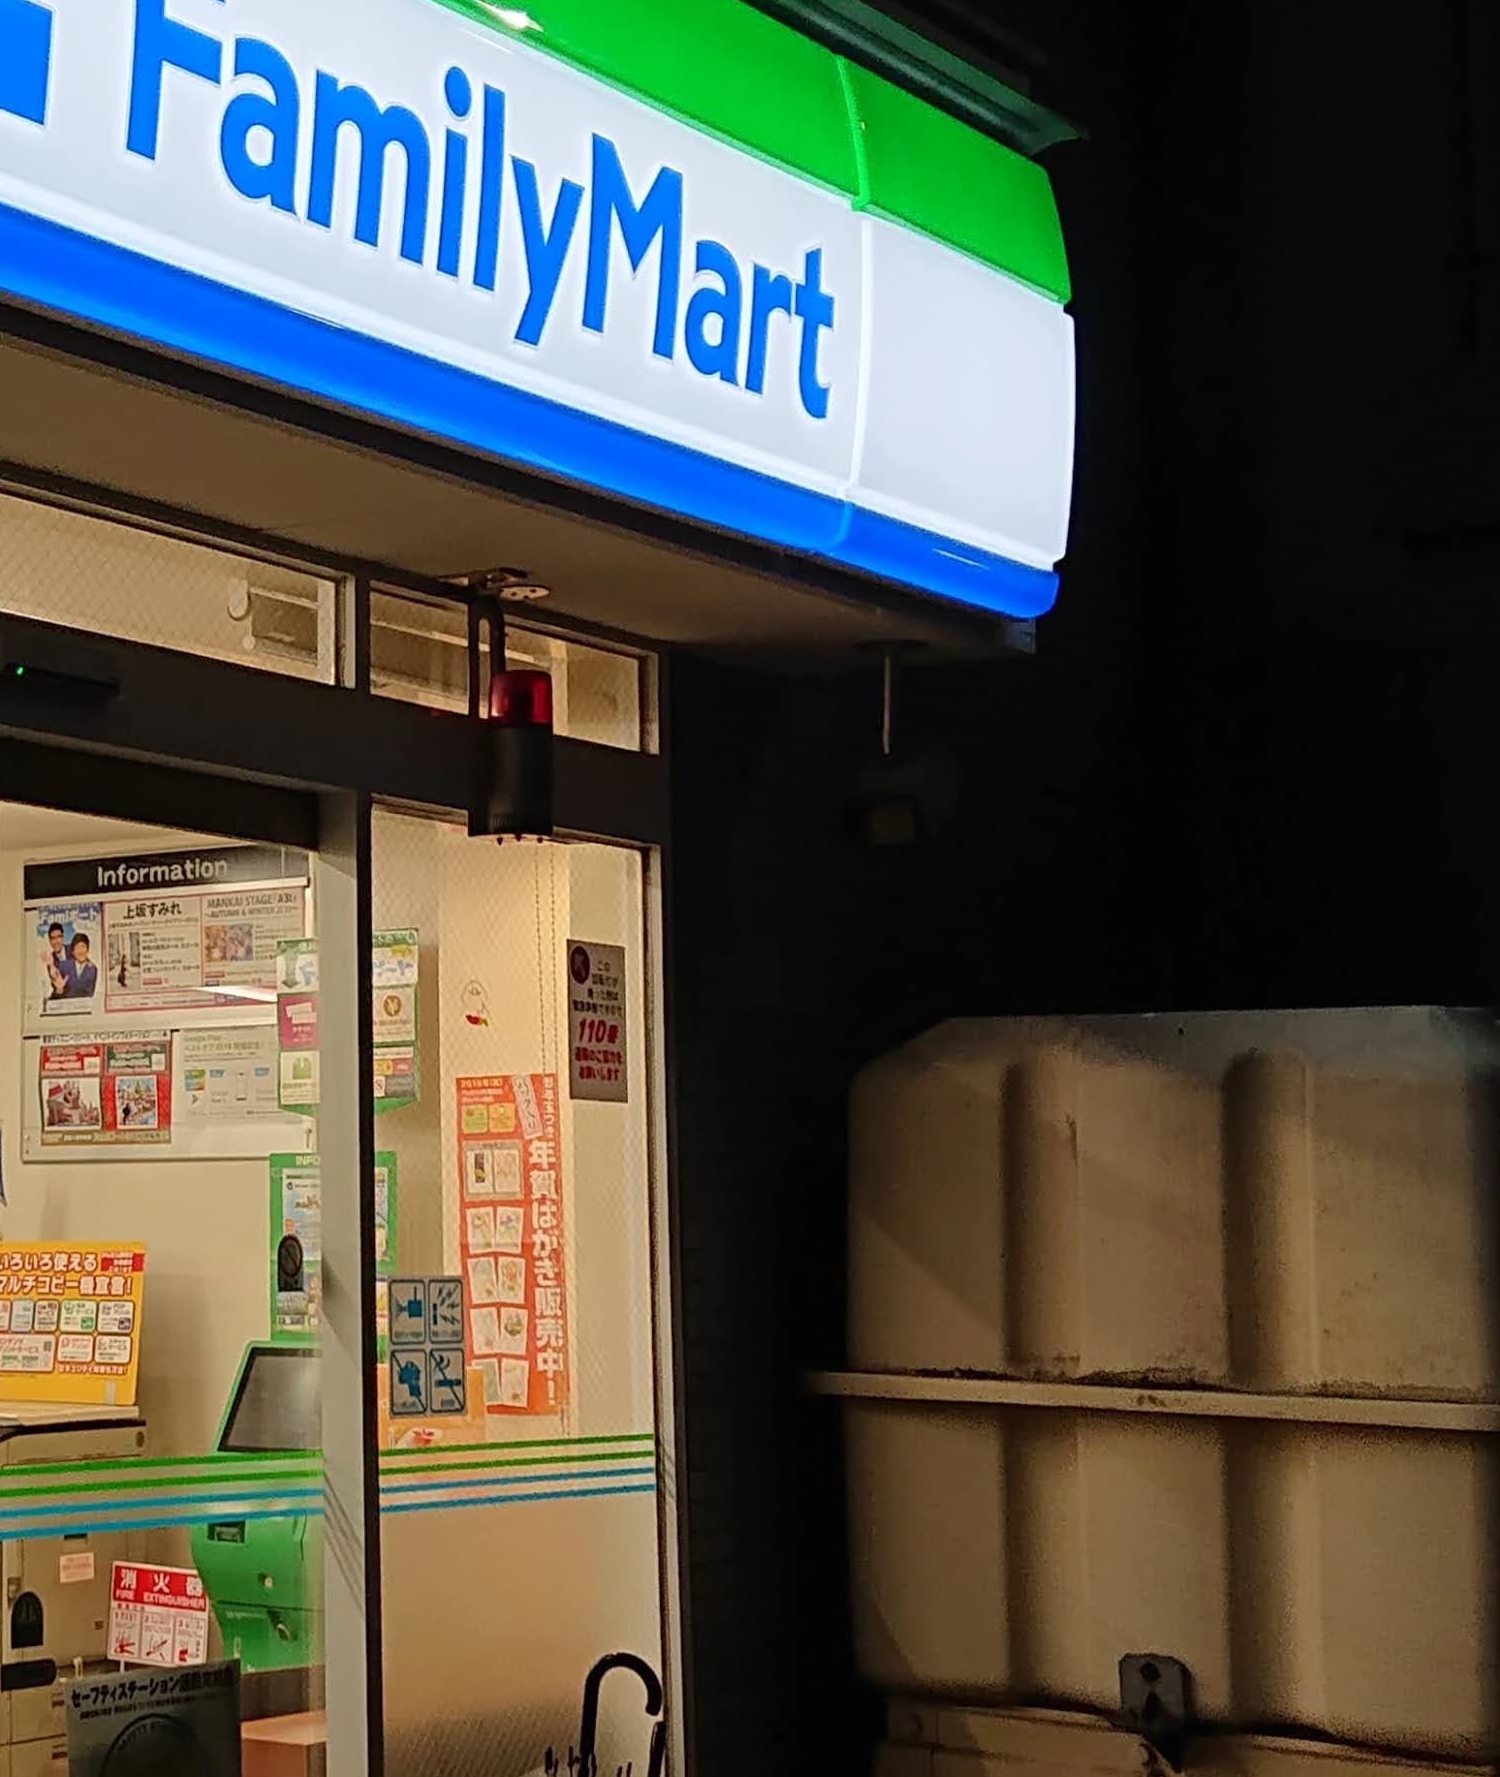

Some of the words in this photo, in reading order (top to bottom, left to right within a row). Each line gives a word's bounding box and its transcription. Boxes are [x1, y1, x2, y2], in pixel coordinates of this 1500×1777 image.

[98, 859, 228, 886] Information
[123, 900, 182, 920] 上坂すみれ
[579, 1018, 619, 1044] 110番
[115, 1588, 136, 1601] FIRE
[119, 1568, 204, 1597] 消火器
